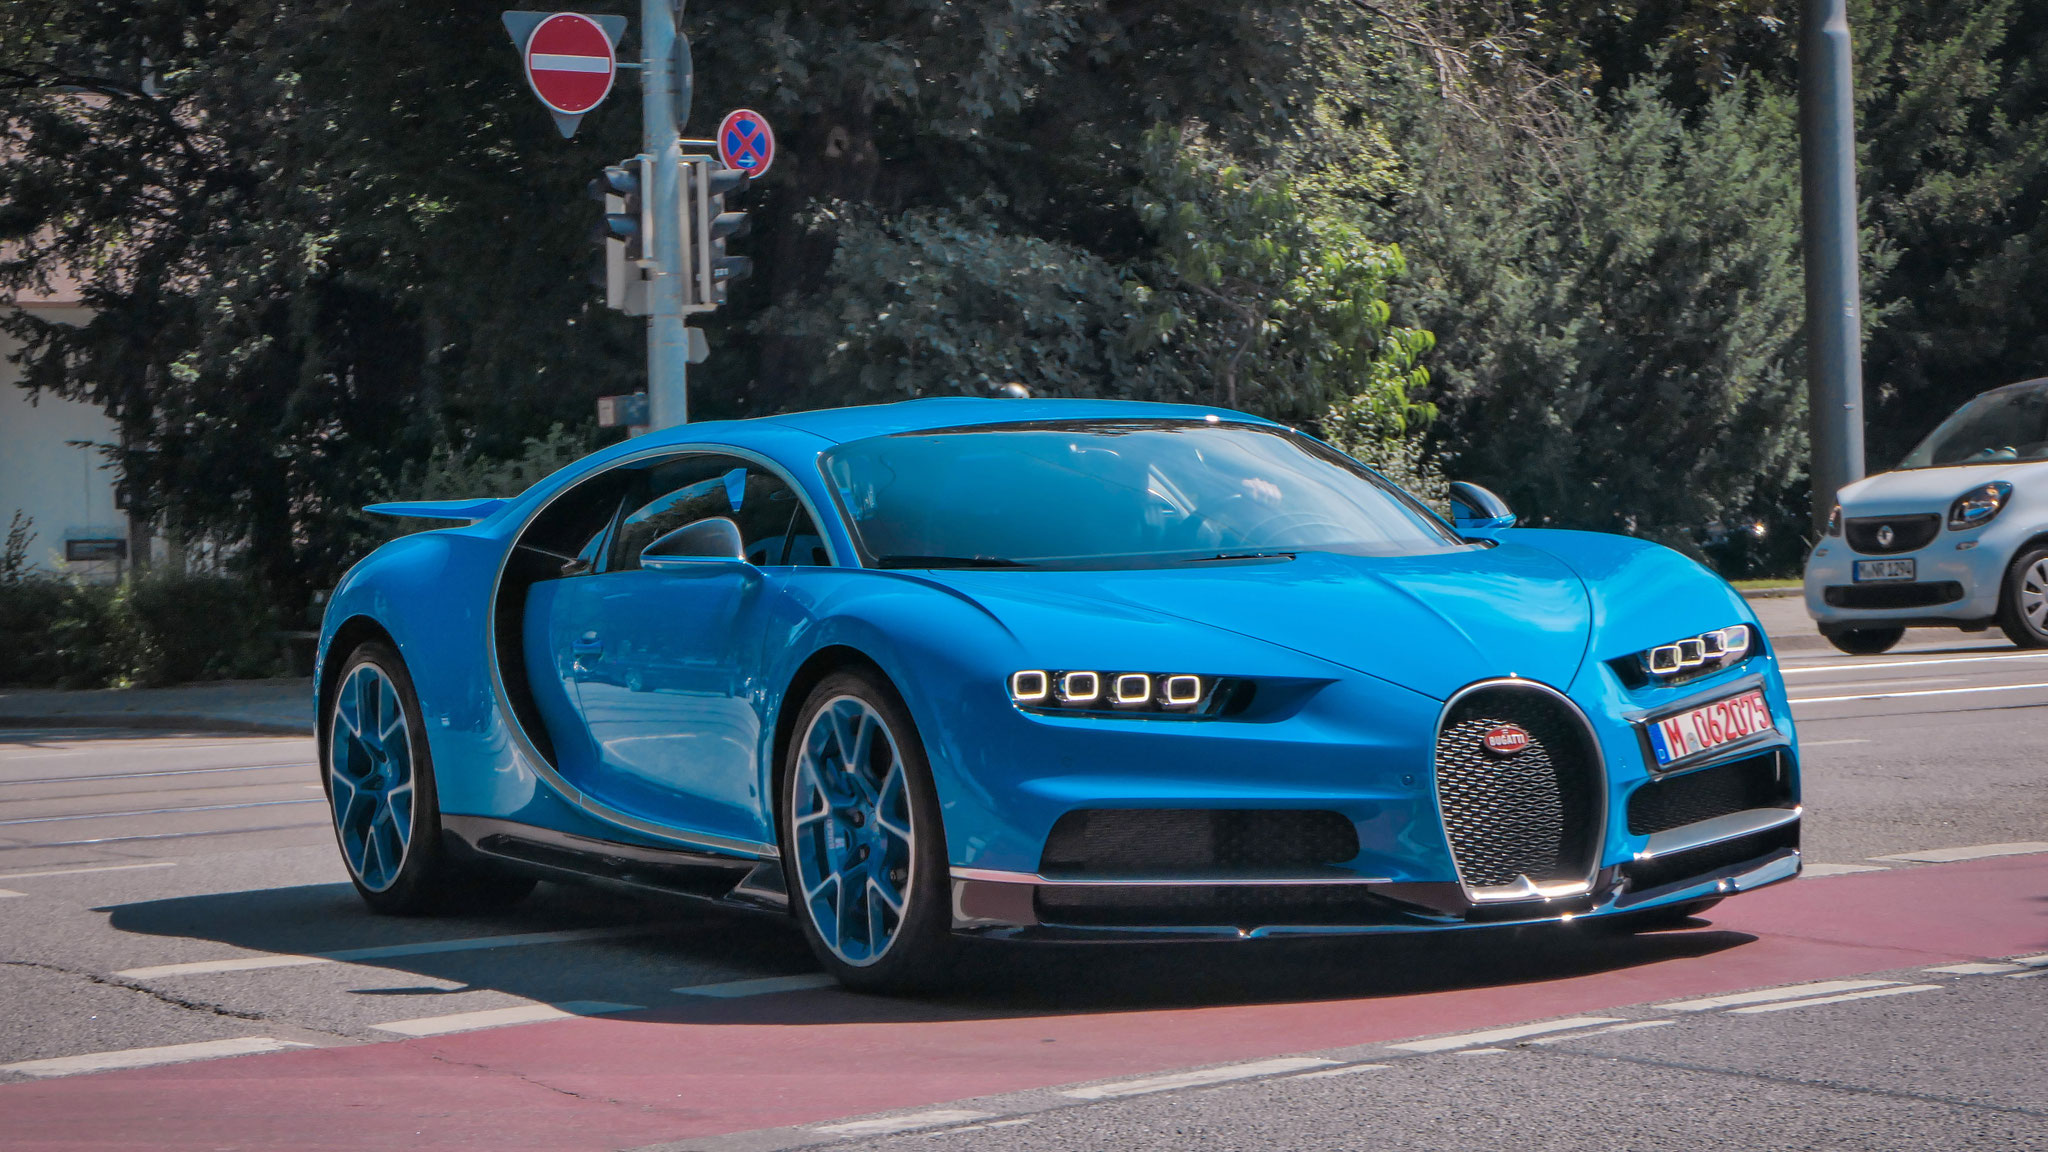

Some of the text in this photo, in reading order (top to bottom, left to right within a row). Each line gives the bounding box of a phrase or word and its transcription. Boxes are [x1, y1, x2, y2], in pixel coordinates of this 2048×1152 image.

[1664, 691, 1770, 758] M 062075
[1489, 734, 1525, 746] BUGATTI
[1658, 749, 1665, 759] D
